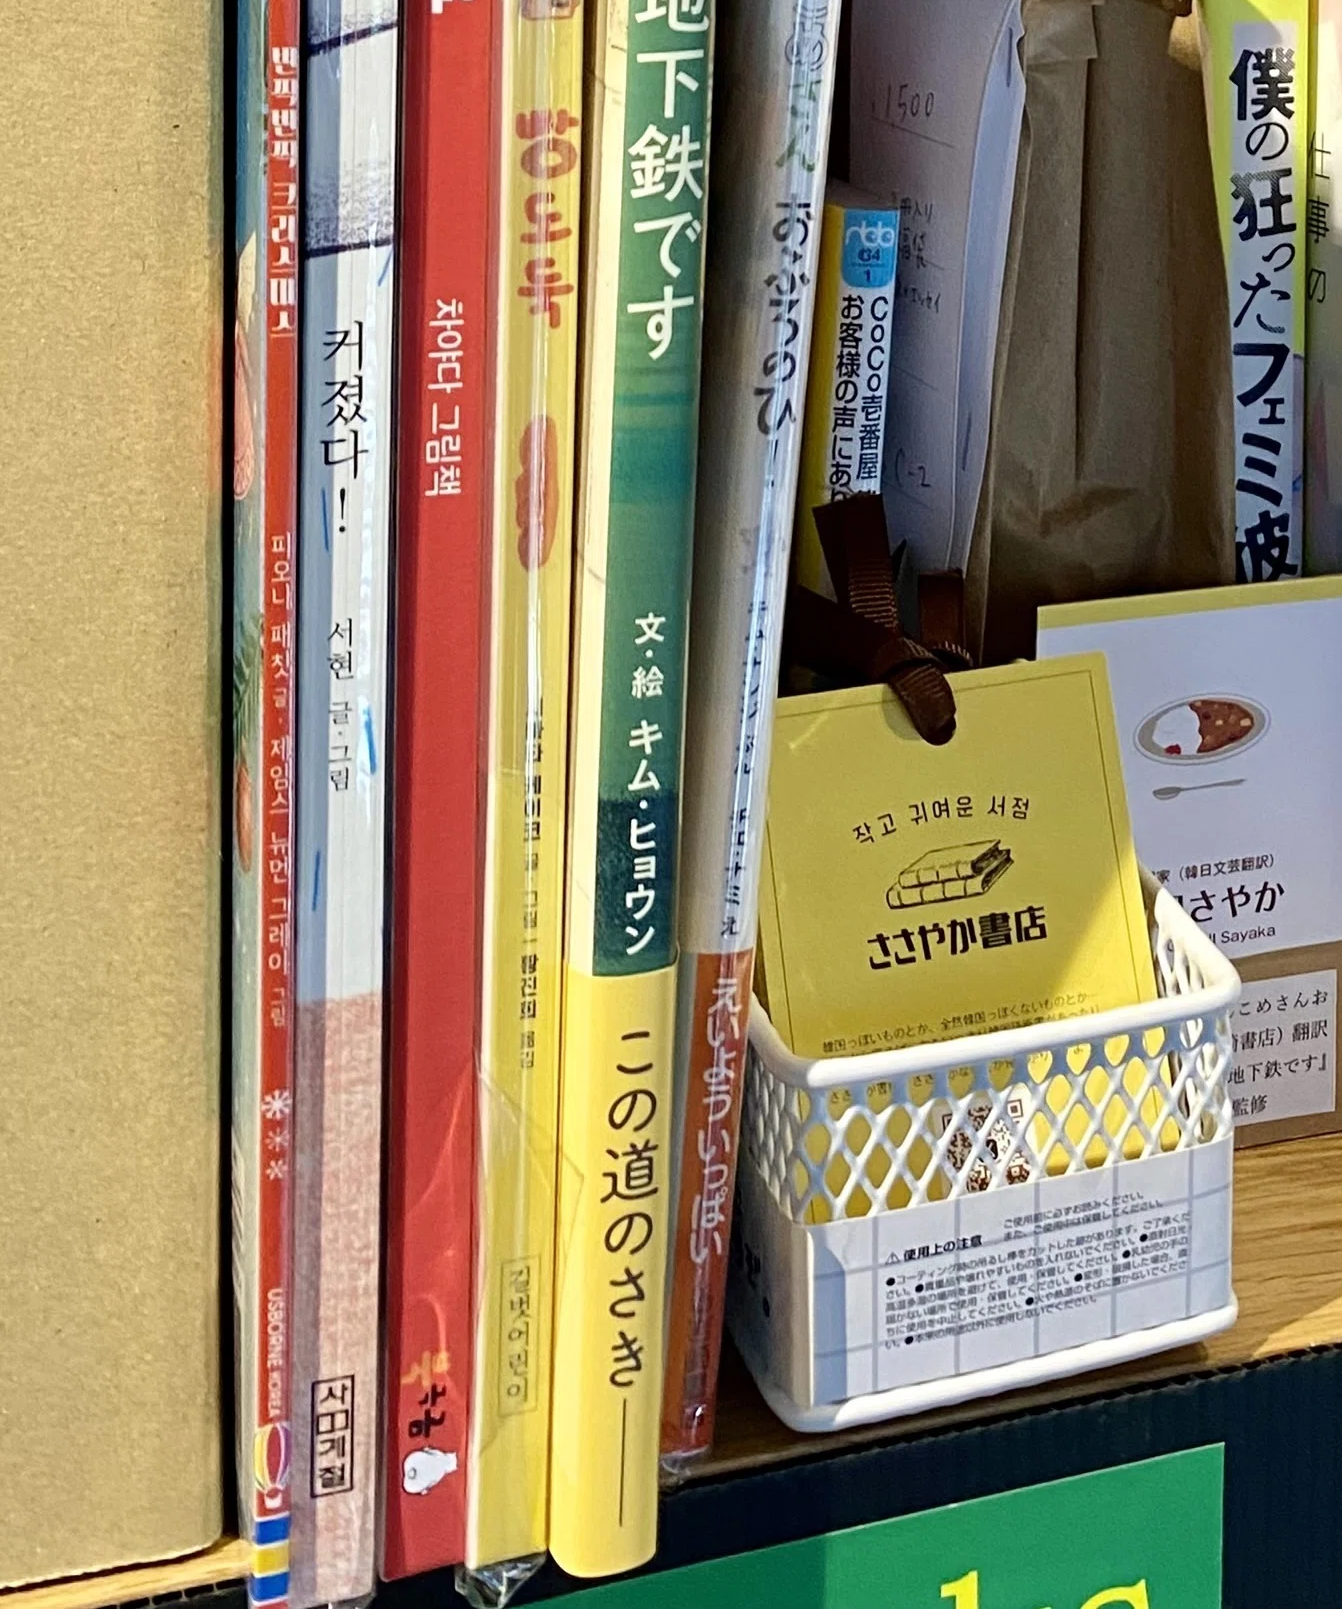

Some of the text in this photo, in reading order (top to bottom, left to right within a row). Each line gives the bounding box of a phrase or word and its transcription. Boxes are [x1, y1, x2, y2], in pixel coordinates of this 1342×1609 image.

[268, 45, 298, 337] 반짝반짝 크리스마스
[1306, 129, 1332, 307] 仕事の
[1229, 46, 1299, 584] 僕の狂ったフェミ彼
[319, 319, 370, 535] 커졌다!
[425, 298, 465, 497] 차야다 그림책
[856, 295, 889, 481] CoCo壱番屋
[271, 531, 292, 610] 피오나
[327, 617, 355, 681] 서현
[625, 612, 666, 956] 文・絵 キム・ヒョウン
[852, 795, 1031, 844] 작고 귀여운 서점
[866, 905, 1049, 970] ささやか書店
[1220, 924, 1277, 945] Sayaka
[903, 1234, 983, 1262] 使用上の注意
[266, 1287, 285, 1368] USBORNE
